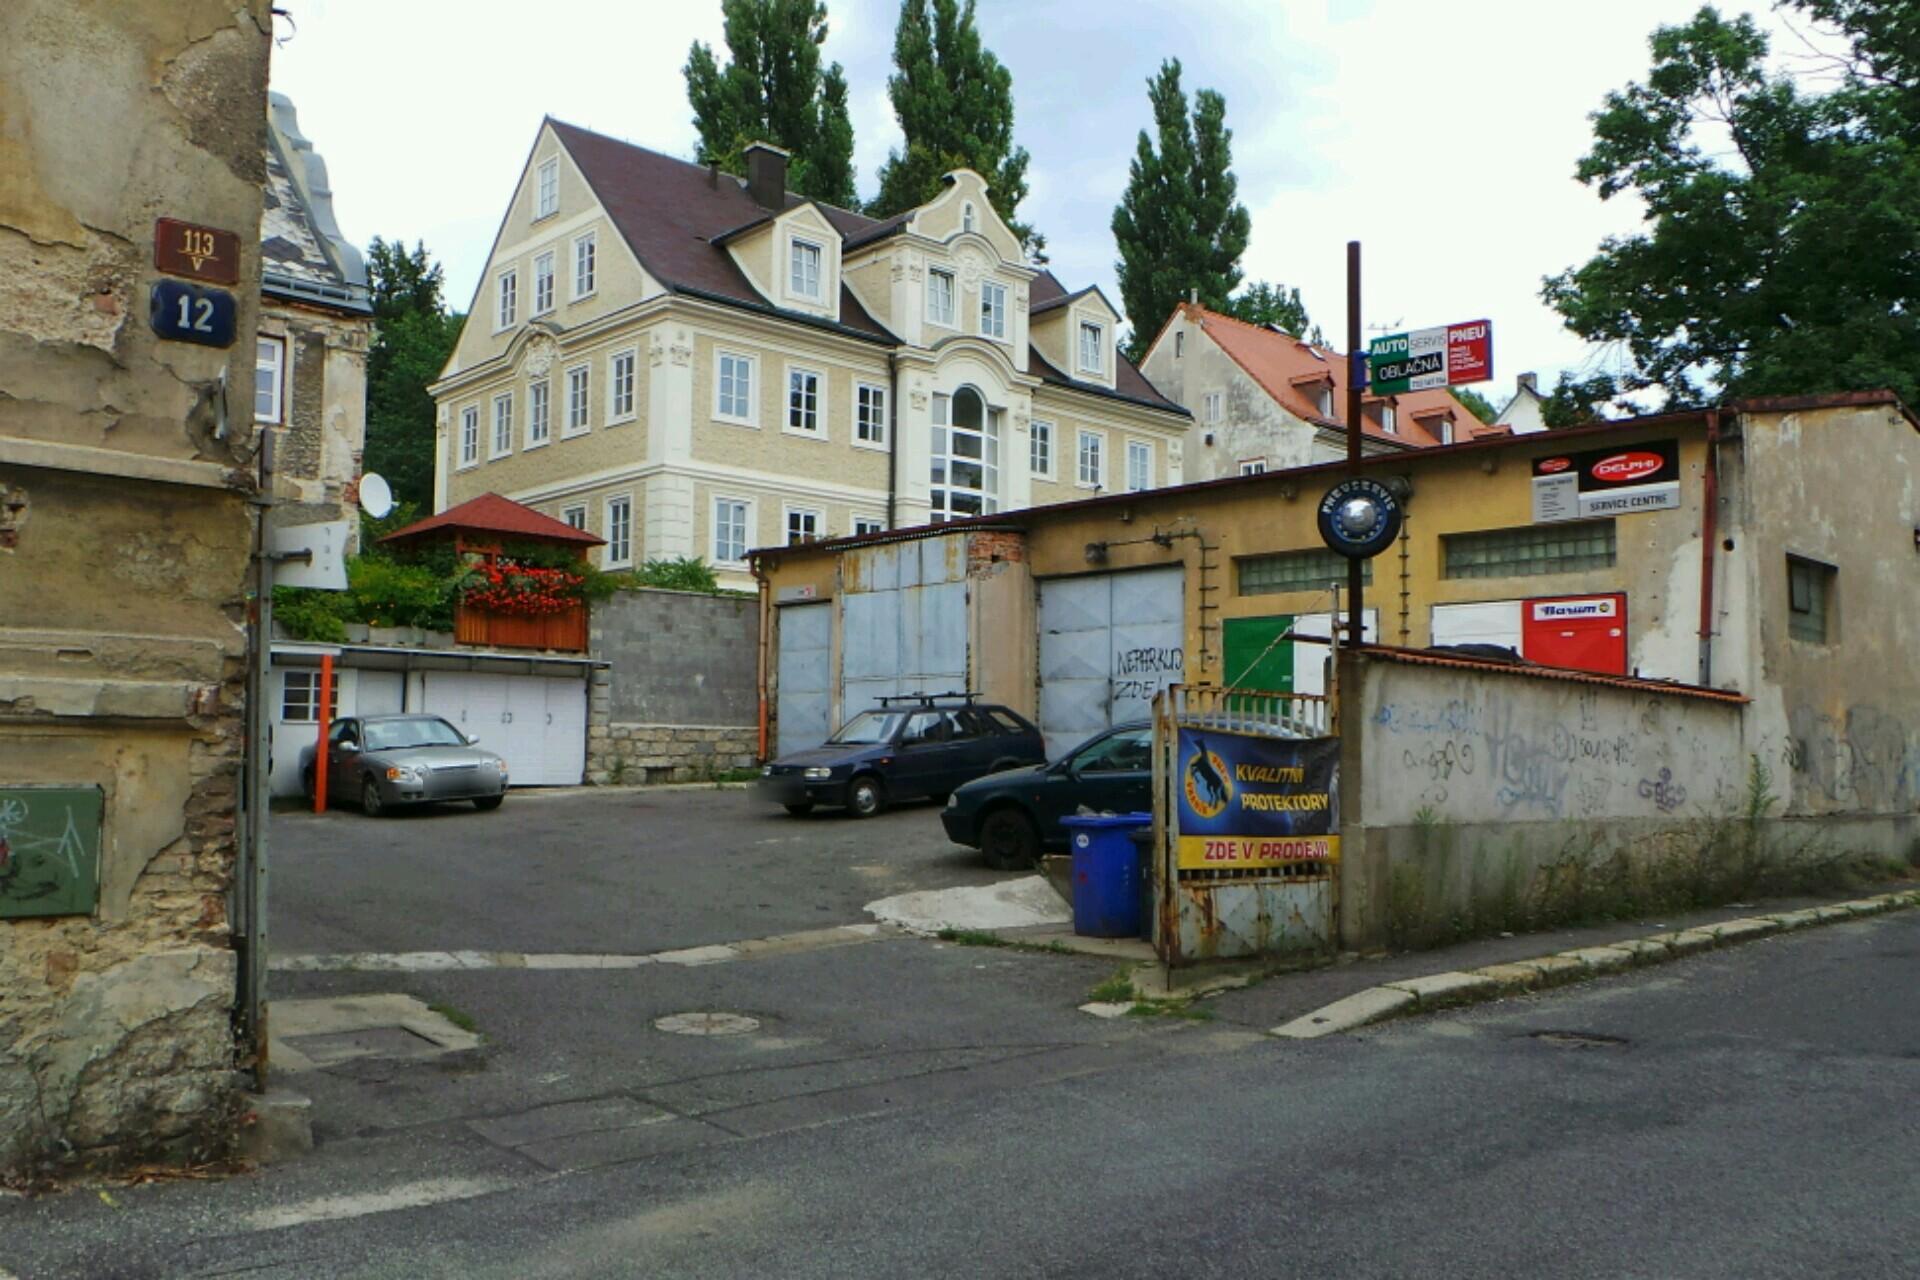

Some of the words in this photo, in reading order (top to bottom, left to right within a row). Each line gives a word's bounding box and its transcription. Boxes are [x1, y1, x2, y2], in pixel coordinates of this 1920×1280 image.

[183, 229, 214, 256] 113
[191, 256, 203, 272] V
[177, 294, 214, 333] 12
[1450, 325, 1486, 343] PNEU
[1372, 338, 1408, 355] AUTO
[1379, 353, 1441, 380] OBLAČNÁ
[1599, 459, 1655, 474] DELPHI
[1321, 480, 1396, 514] PNEUSERVIS
[1590, 497, 1629, 512] SERVICE
[1631, 493, 1668, 508] CENTRE
[1240, 793, 1329, 811] PROTEKTORY
[1204, 842, 1237, 861] ZDE
[1242, 842, 1254, 860] V
